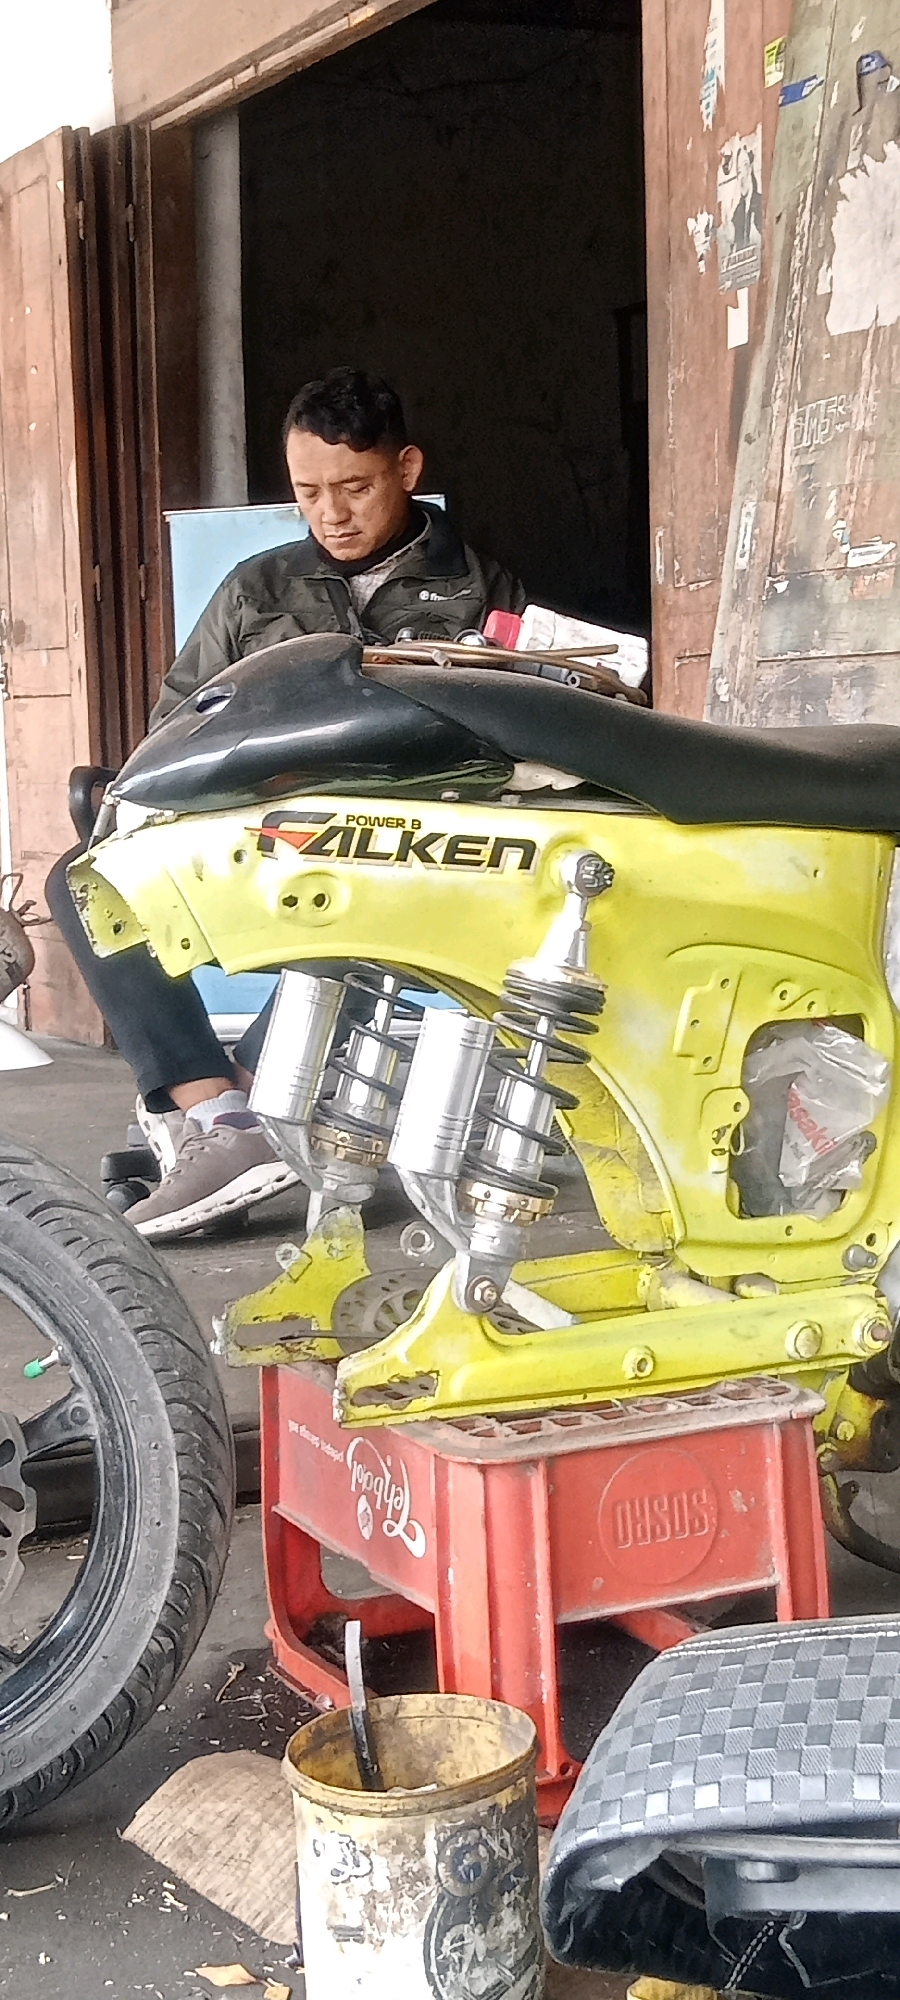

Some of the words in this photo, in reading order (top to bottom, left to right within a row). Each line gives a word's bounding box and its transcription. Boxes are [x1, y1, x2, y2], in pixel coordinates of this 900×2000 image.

[255, 810, 539, 874] FALKEN
[346, 814, 405, 829] POWER
[411, 817, 422, 830] B
[787, 1090, 839, 1155] asaki
[614, 1487, 709, 1549] SOSRO
